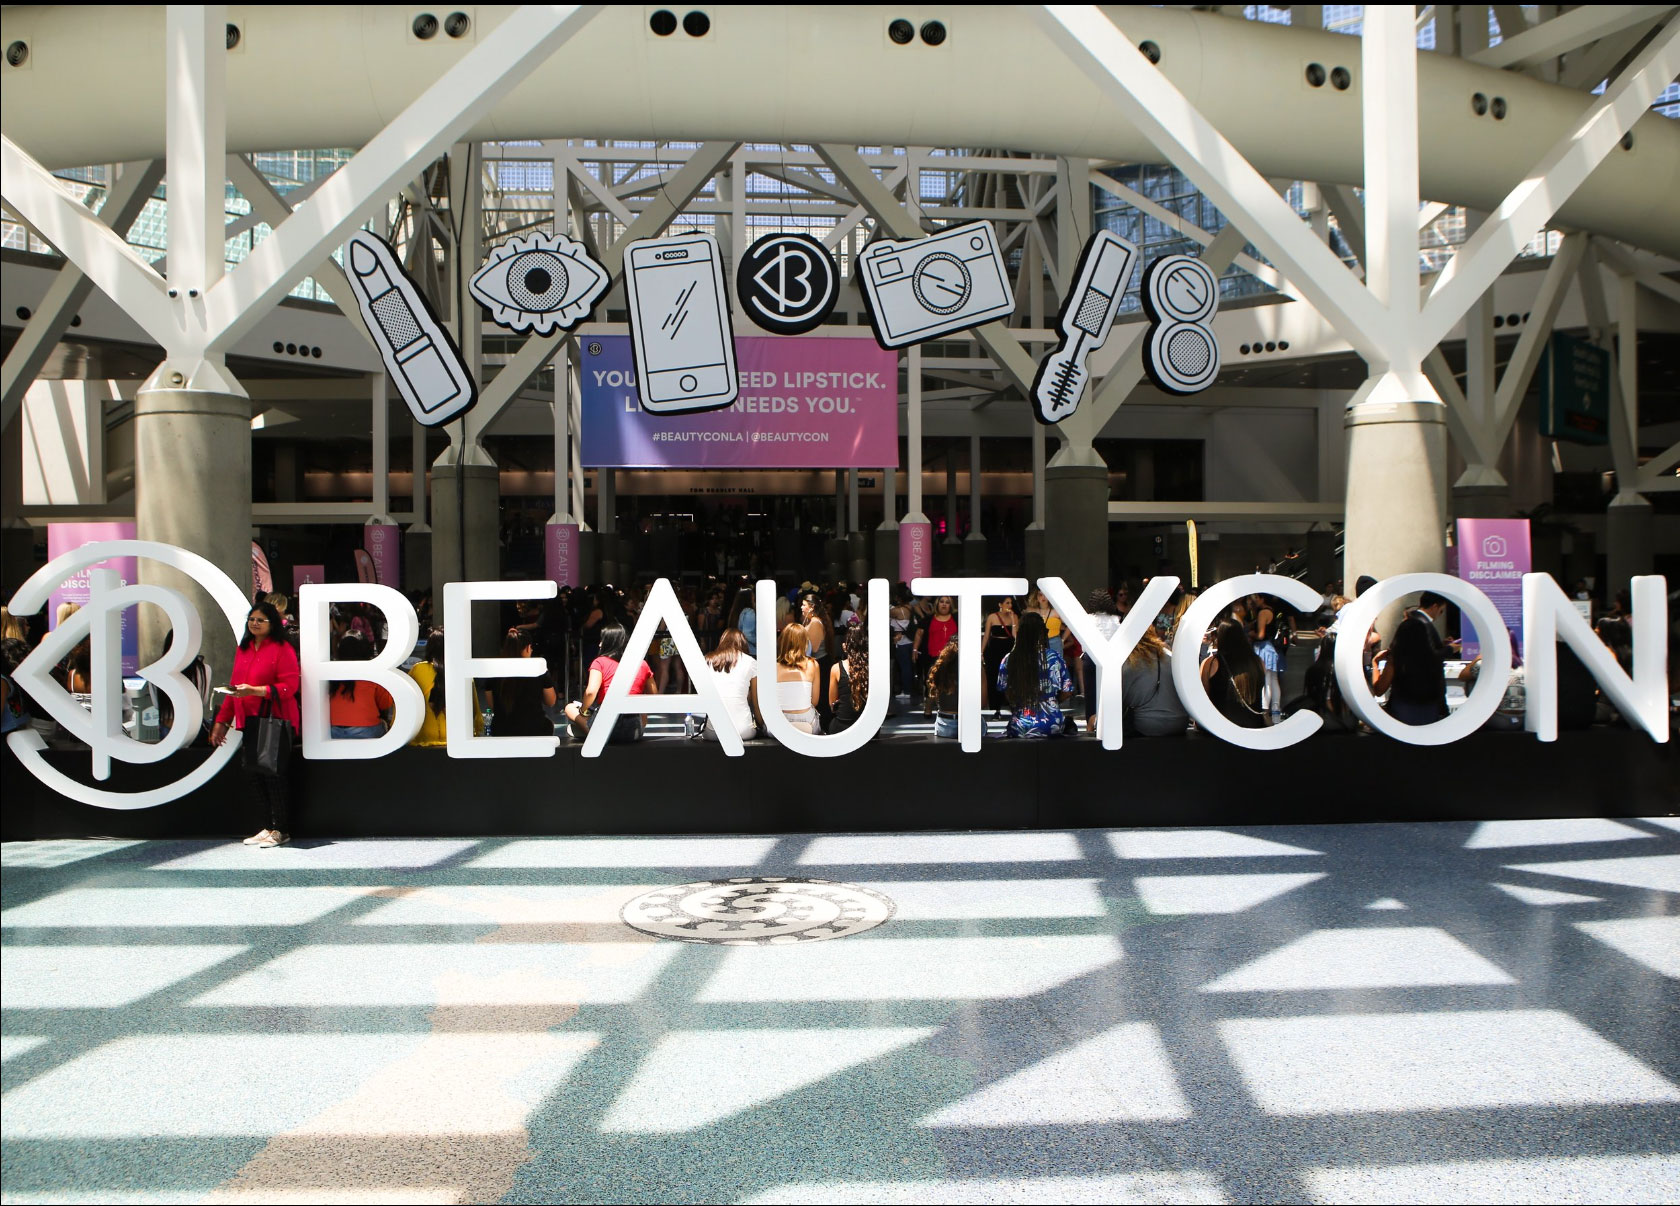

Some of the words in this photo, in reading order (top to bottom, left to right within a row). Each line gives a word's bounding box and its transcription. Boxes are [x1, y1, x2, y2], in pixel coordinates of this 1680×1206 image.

[593, 370, 636, 388] YOU
[738, 371, 777, 388] EED
[784, 372, 886, 389] LIPSTICK.
[730, 396, 799, 413] NEEDS
[805, 397, 856, 413] YOU.
[653, 432, 743, 442] #BEAUTYCONLA
[751, 432, 829, 442] @BEAUTYCON
[913, 541, 922, 578] BEAUT
[1477, 561, 1514, 570] FILMING
[1469, 571, 1522, 579] DISCLAIMER
[299, 573, 1669, 760] BEAUTYCON
